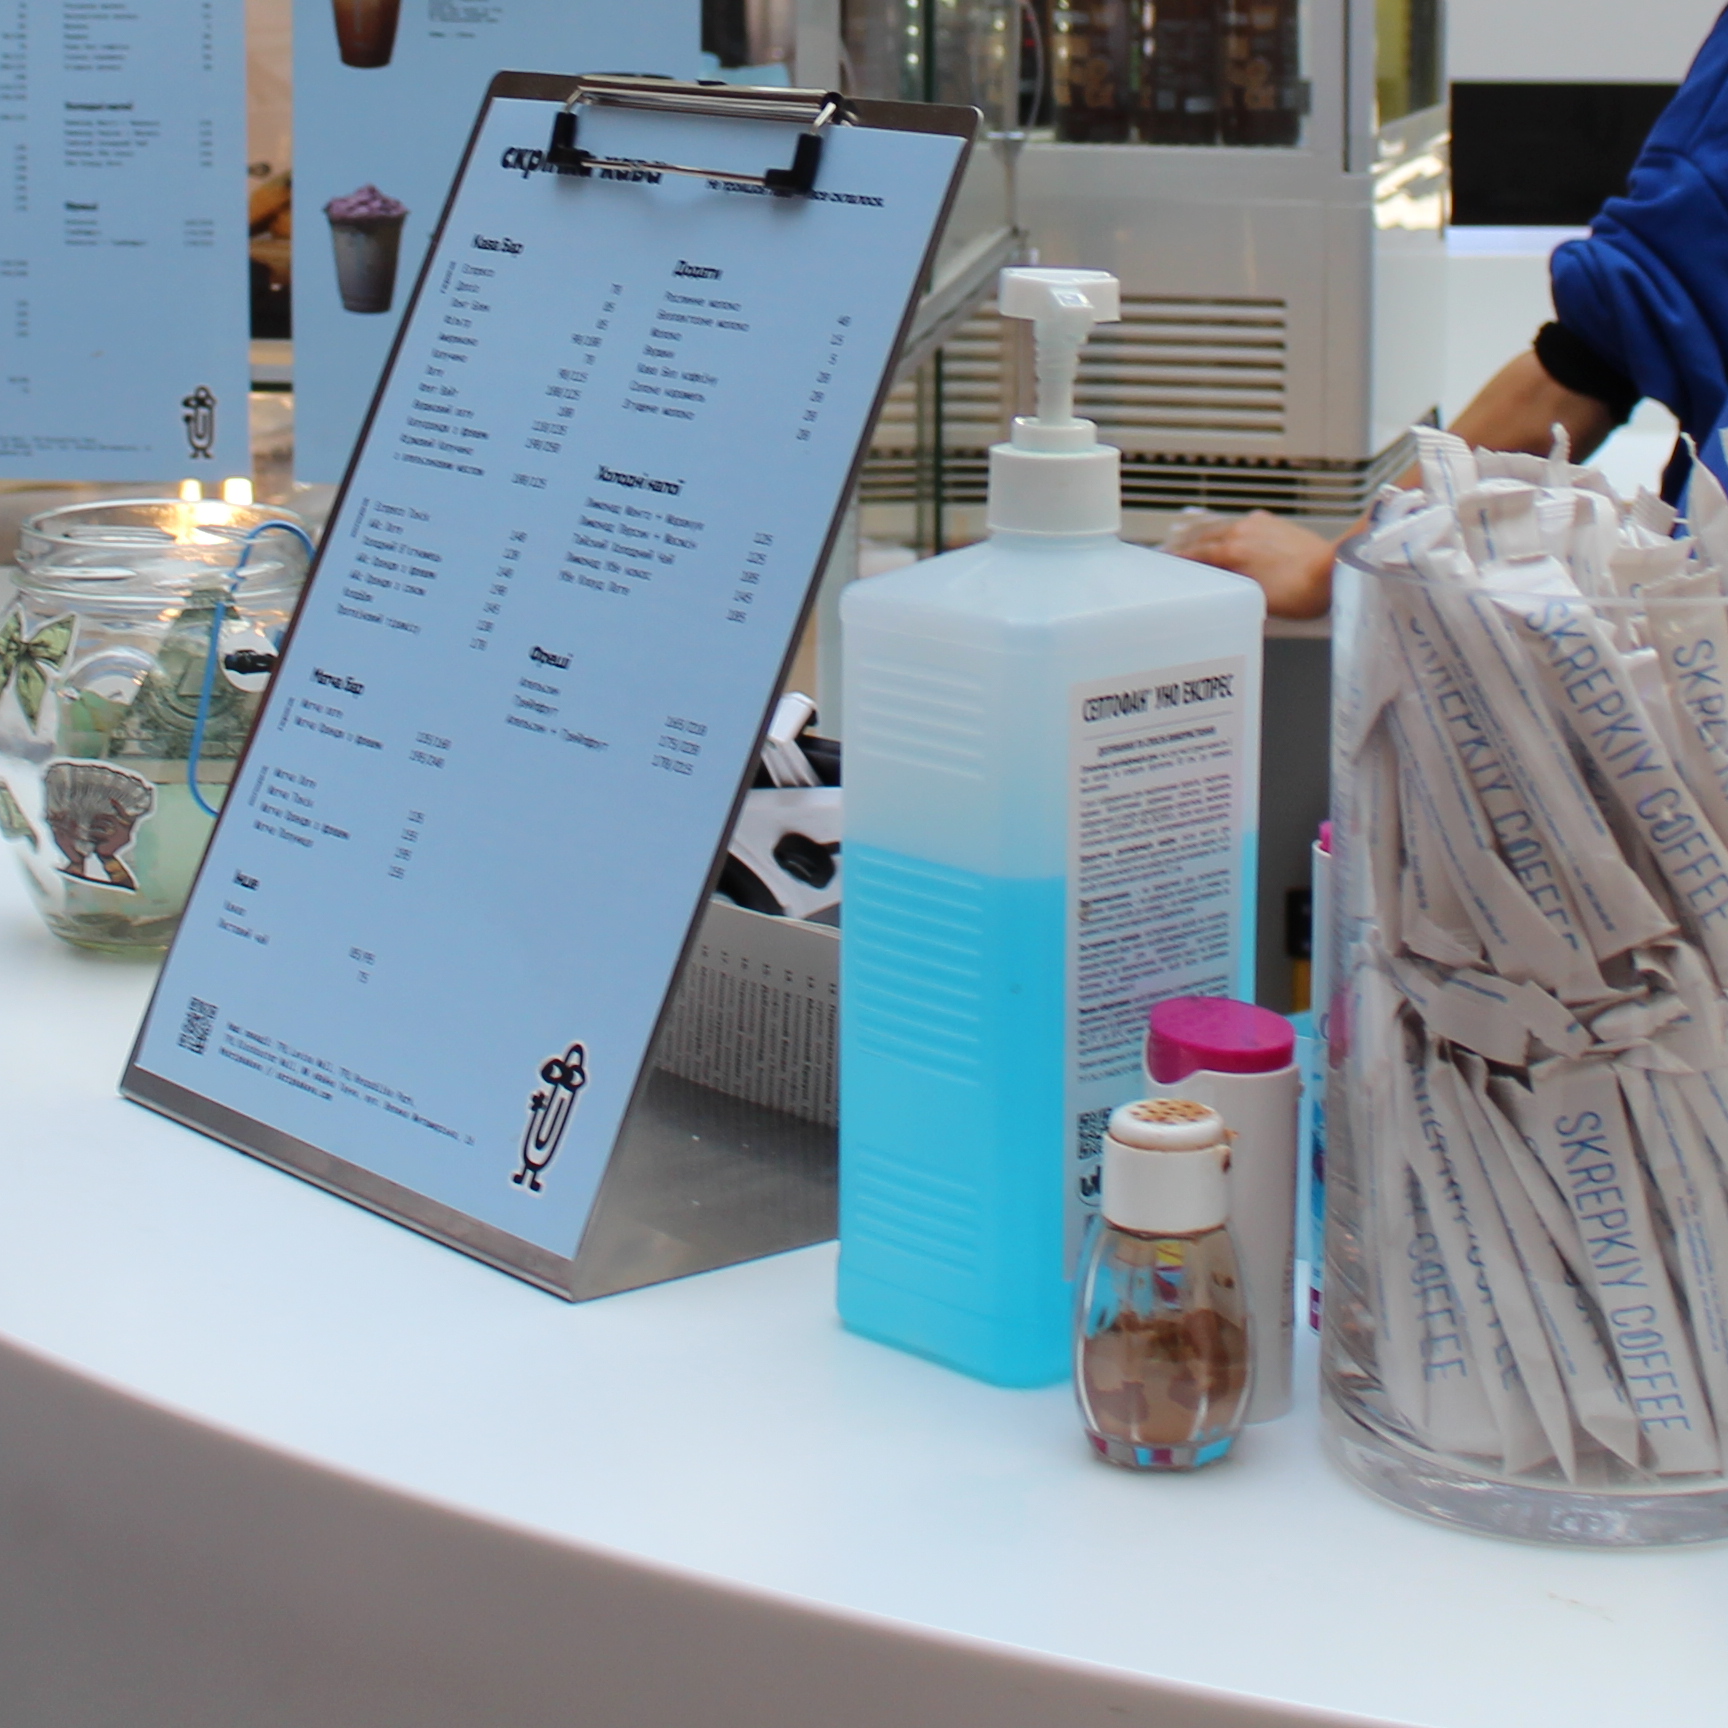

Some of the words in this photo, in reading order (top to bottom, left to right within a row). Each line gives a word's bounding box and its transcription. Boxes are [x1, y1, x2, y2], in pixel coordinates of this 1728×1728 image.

[474, 235, 499, 251] Кава
[598, 466, 644, 487] Холодні
[647, 480, 683, 495] напої
[530, 646, 568, 668] Фреші
[1526, 600, 1663, 781] SKREPKIY
[1554, 1109, 1648, 1294] SKREPKIY
[1607, 1303, 1691, 1434] COFFEE
